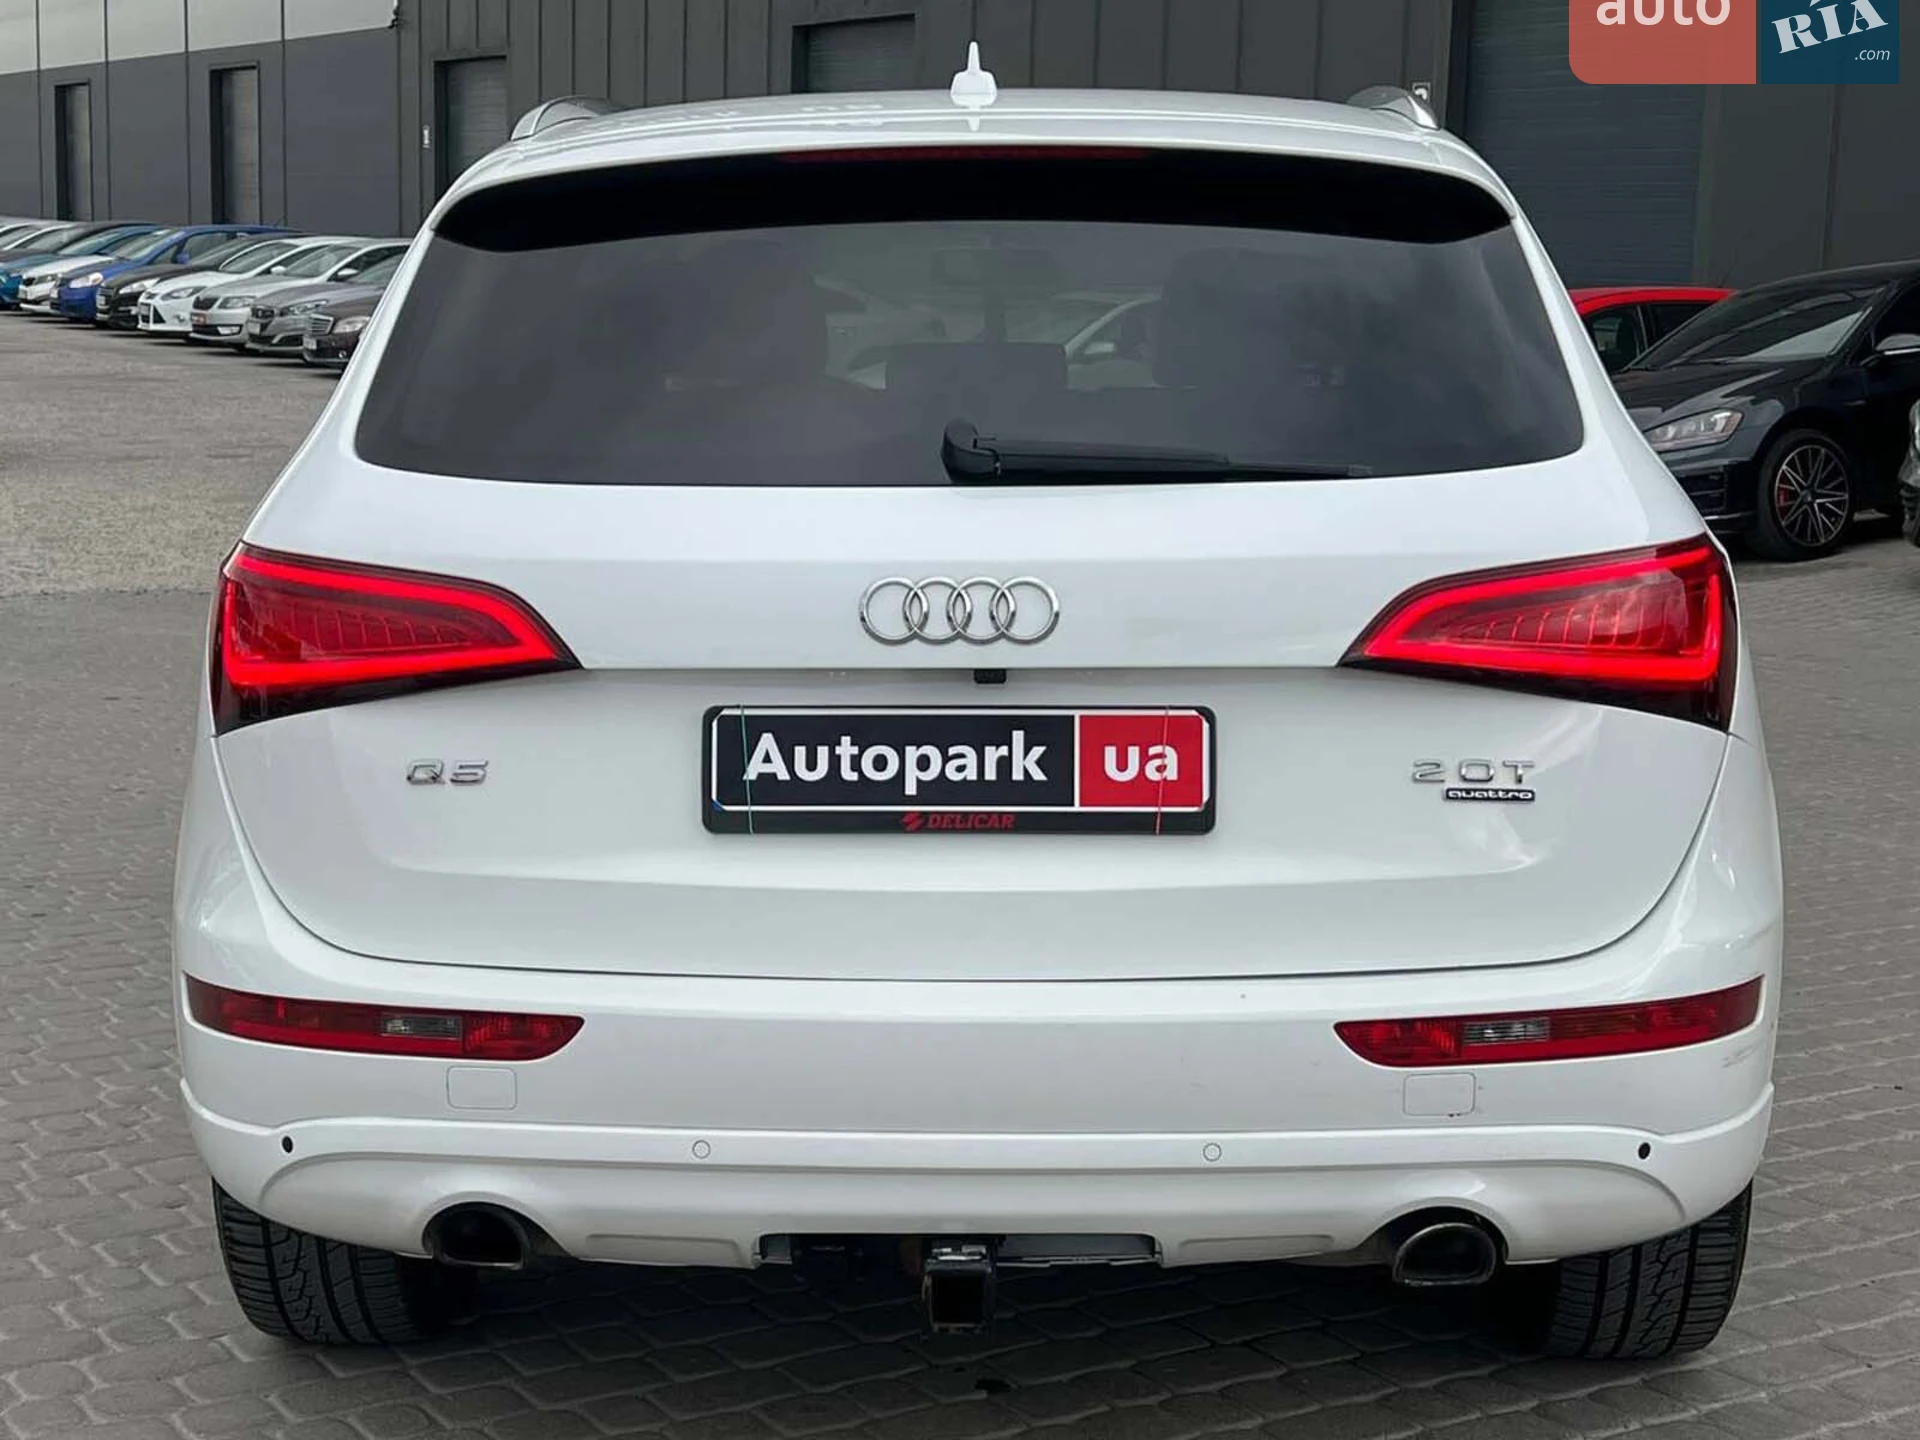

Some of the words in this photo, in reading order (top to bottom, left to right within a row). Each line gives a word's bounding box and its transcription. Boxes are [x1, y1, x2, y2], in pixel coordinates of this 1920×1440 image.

[406, 759, 489, 785] Q5
[743, 730, 1047, 796] Autopark
[1103, 743, 1179, 781] ua
[1448, 789, 1533, 799] quattro
[927, 813, 1016, 829] DELICAR
